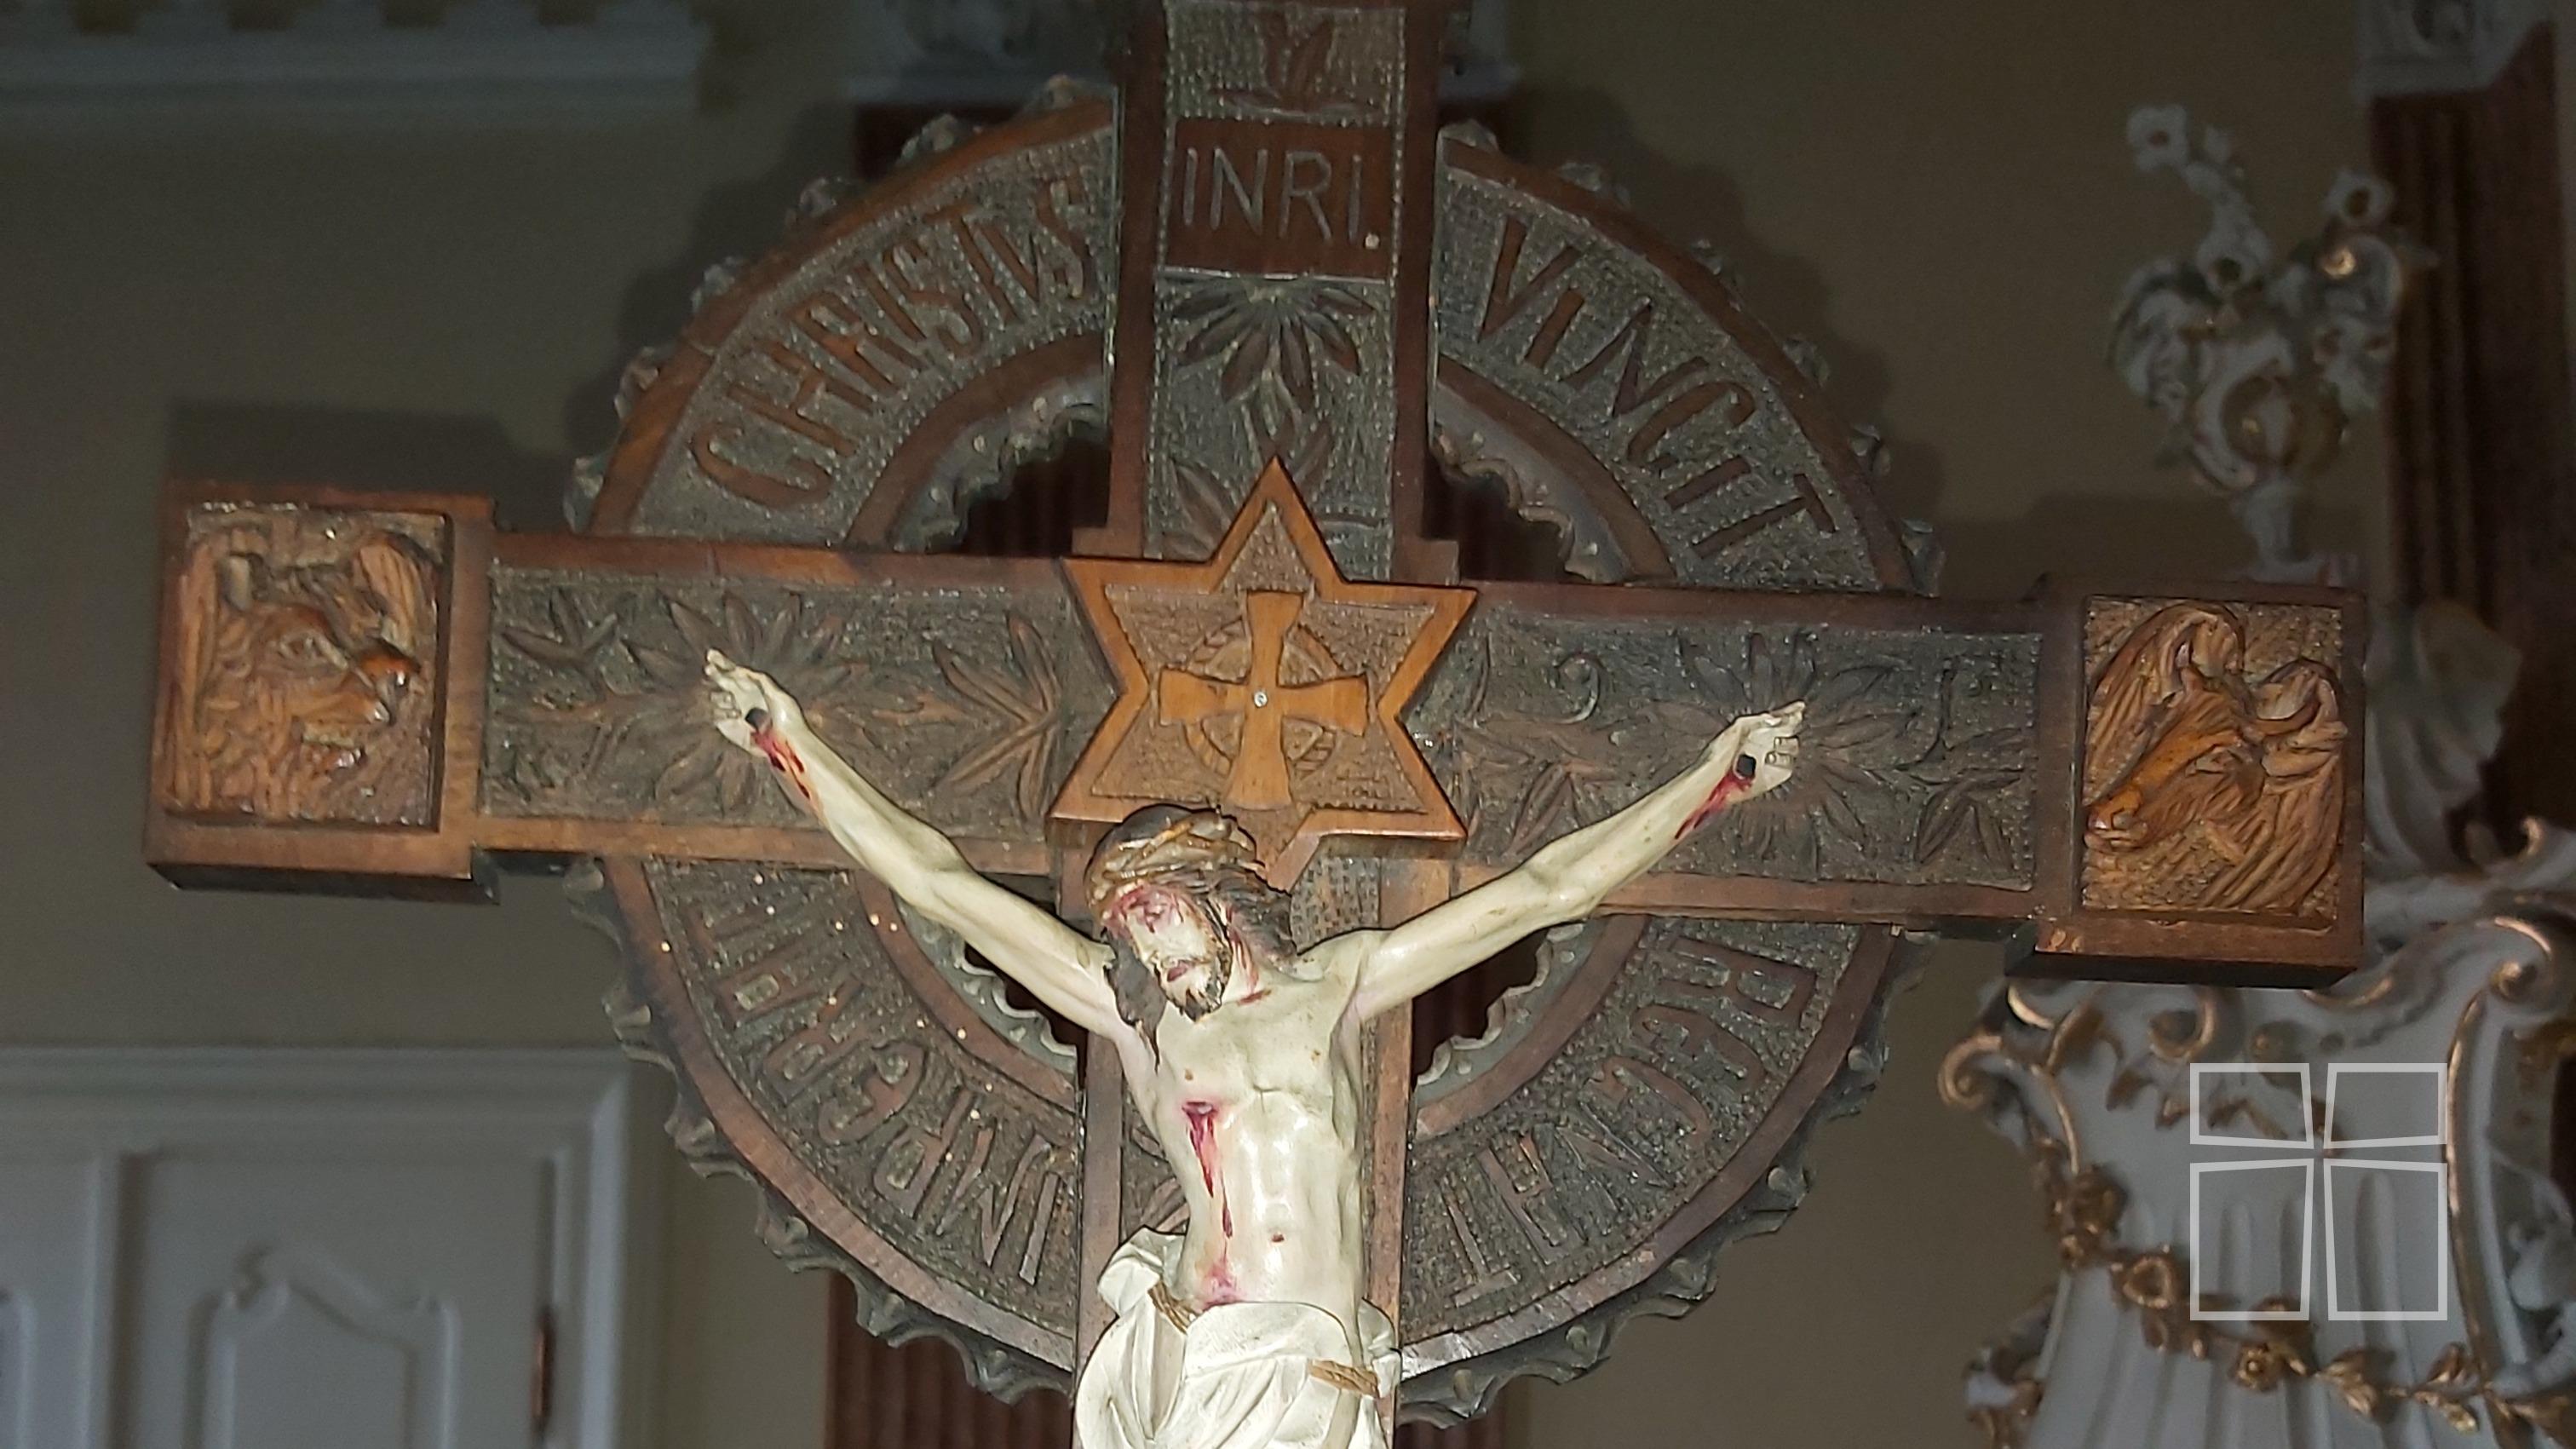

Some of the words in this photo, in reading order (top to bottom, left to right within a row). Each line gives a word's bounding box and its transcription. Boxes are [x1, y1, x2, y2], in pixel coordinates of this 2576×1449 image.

[690, 171, 1099, 507] CHRISTVS
[1477, 212, 1837, 559] VINCIT
[681, 899, 1053, 1286] IMPERAT
[1438, 938, 1817, 1308] REGNAT
